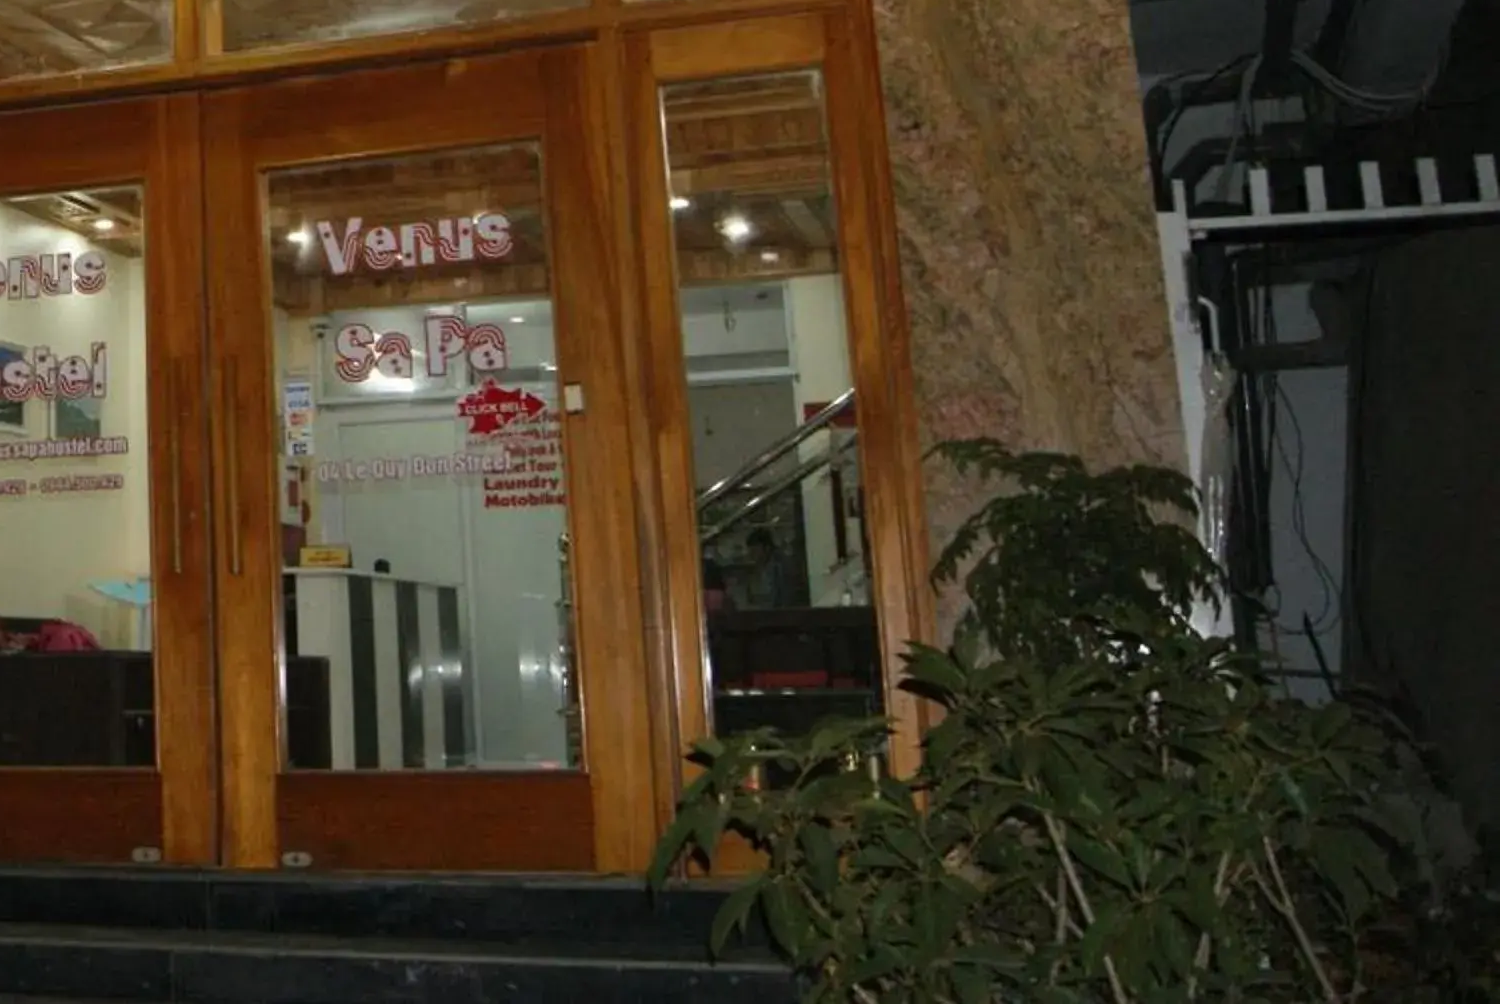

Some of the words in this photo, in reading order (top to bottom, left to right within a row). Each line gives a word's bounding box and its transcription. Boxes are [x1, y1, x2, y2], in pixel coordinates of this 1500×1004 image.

[316, 210, 513, 276] Venus
[319, 463, 340, 482] 04
[345, 462, 368, 481] Le
[413, 455, 450, 477] Don
[454, 451, 512, 475] Street
[483, 476, 559, 491] Laundry
